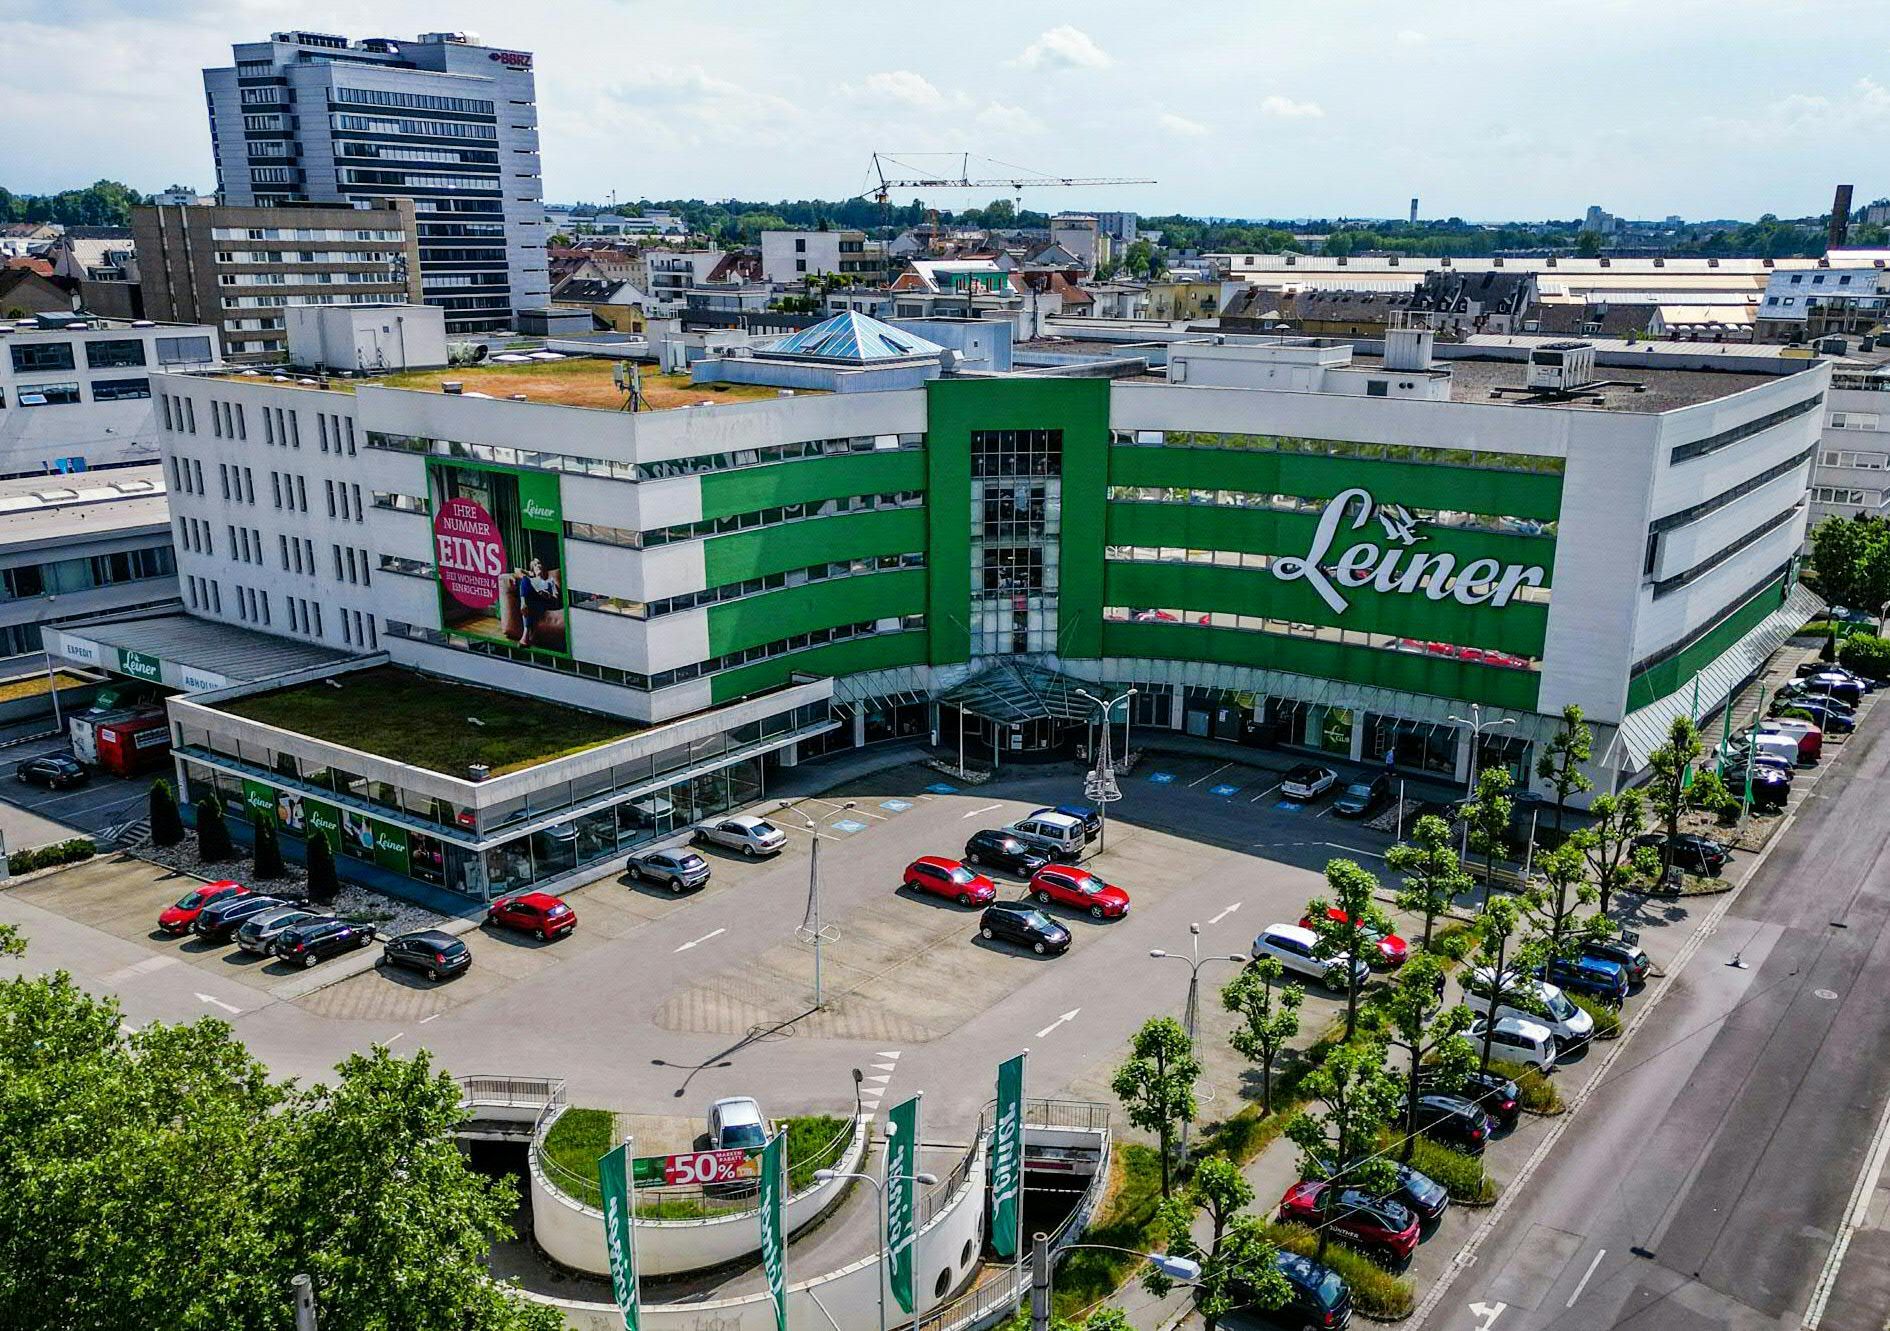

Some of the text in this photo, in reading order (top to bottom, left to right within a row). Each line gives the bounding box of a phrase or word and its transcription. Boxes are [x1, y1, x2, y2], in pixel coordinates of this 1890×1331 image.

[501, 53, 531, 66] BBRZ
[453, 504, 477, 519] IHRE
[522, 499, 555, 518] Leiner
[443, 518, 490, 536] NUMMER
[437, 535, 502, 576] EINS
[1272, 488, 1545, 615] Leiner
[458, 573, 490, 588] WOHNEN
[452, 583, 493, 598] EINRICHTEN
[67, 644, 92, 659] EXPEDIT
[123, 650, 157, 676] Leiner
[247, 790, 273, 810] Leiner
[310, 811, 337, 831] Leiner
[376, 833, 405, 853] Leiner
